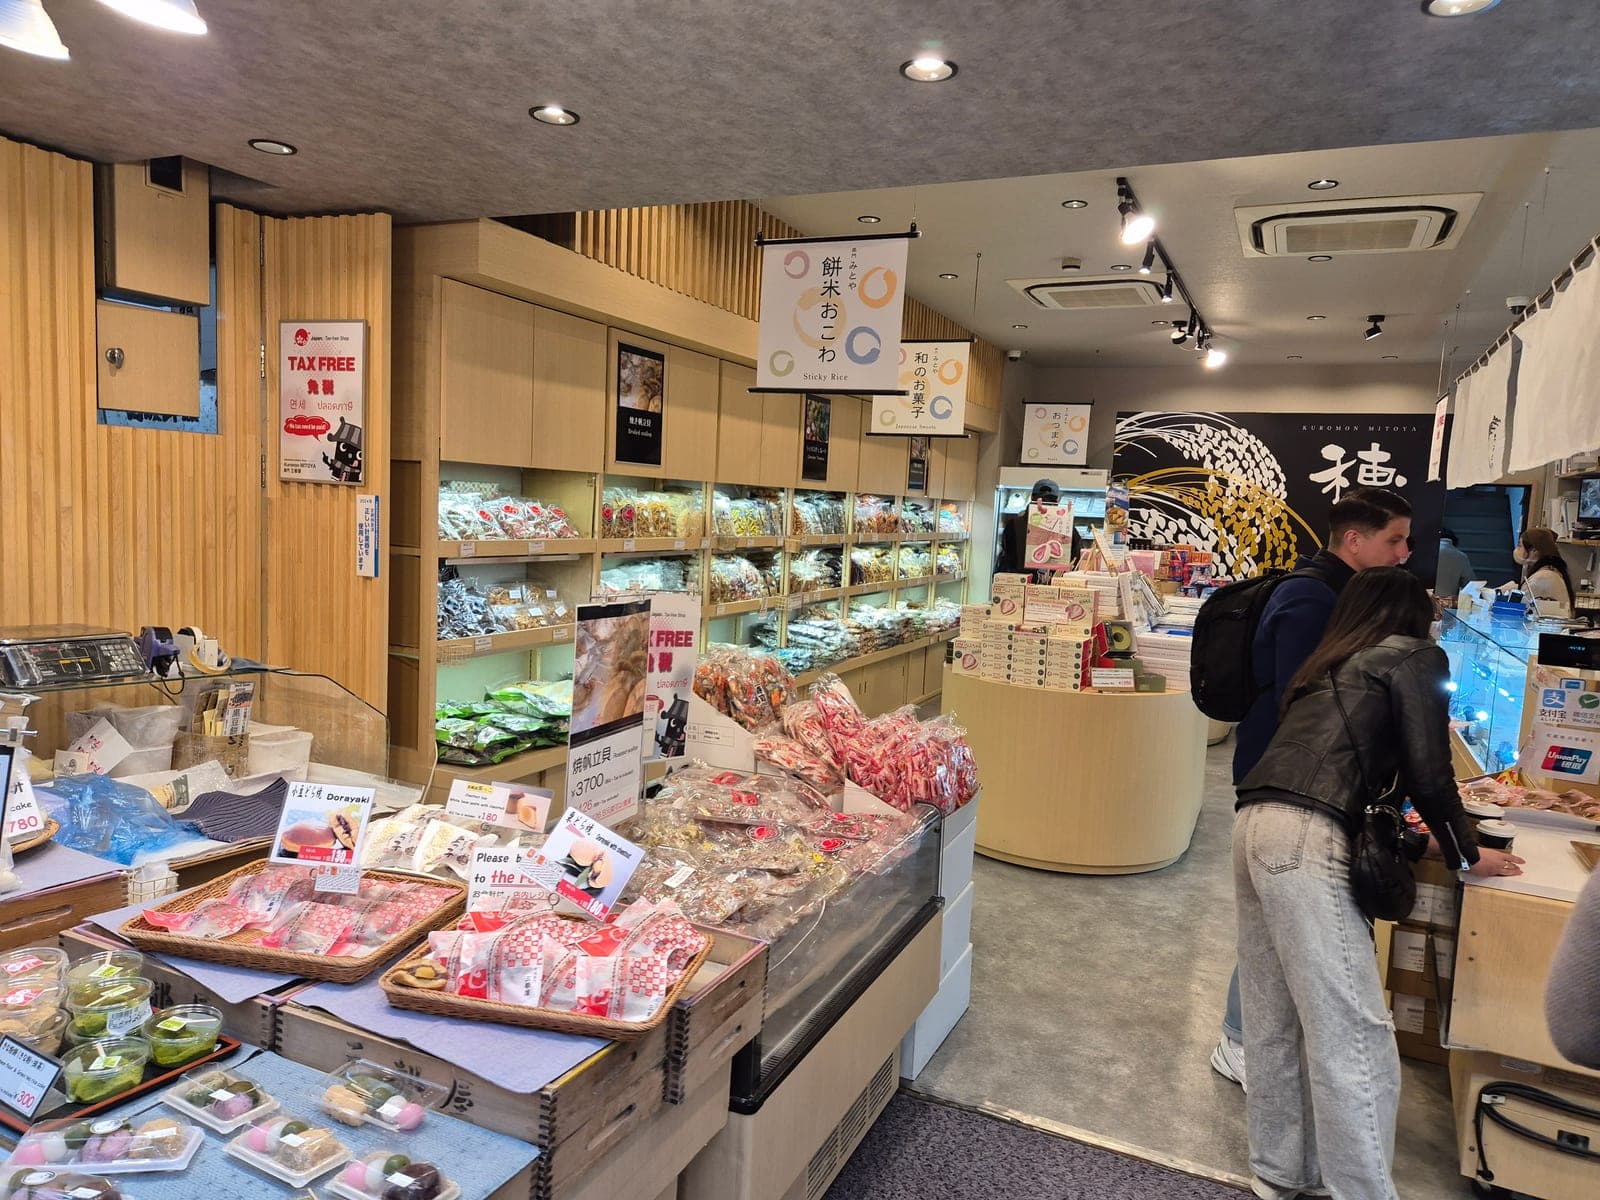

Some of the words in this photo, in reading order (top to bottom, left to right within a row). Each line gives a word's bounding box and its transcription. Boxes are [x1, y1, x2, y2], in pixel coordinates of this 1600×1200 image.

[818, 256, 842, 363] 餅米おこわ
[287, 356, 316, 371] TAX
[318, 356, 356, 372] FREE
[803, 373, 828, 382] Sticky
[830, 373, 849, 381] Rice
[911, 351, 929, 419] 和のお菓子
[1049, 412, 1062, 449] おつまみ
[656, 630, 694, 647] FREE
[1539, 709, 1567, 719] 支付宝
[1547, 751, 1588, 766] UnionPay
[326, 793, 370, 804] Dorayaki
[476, 852, 510, 863] Please
[516, 854, 523, 863] b
[474, 873, 486, 883] to
[491, 870, 515, 884] the
